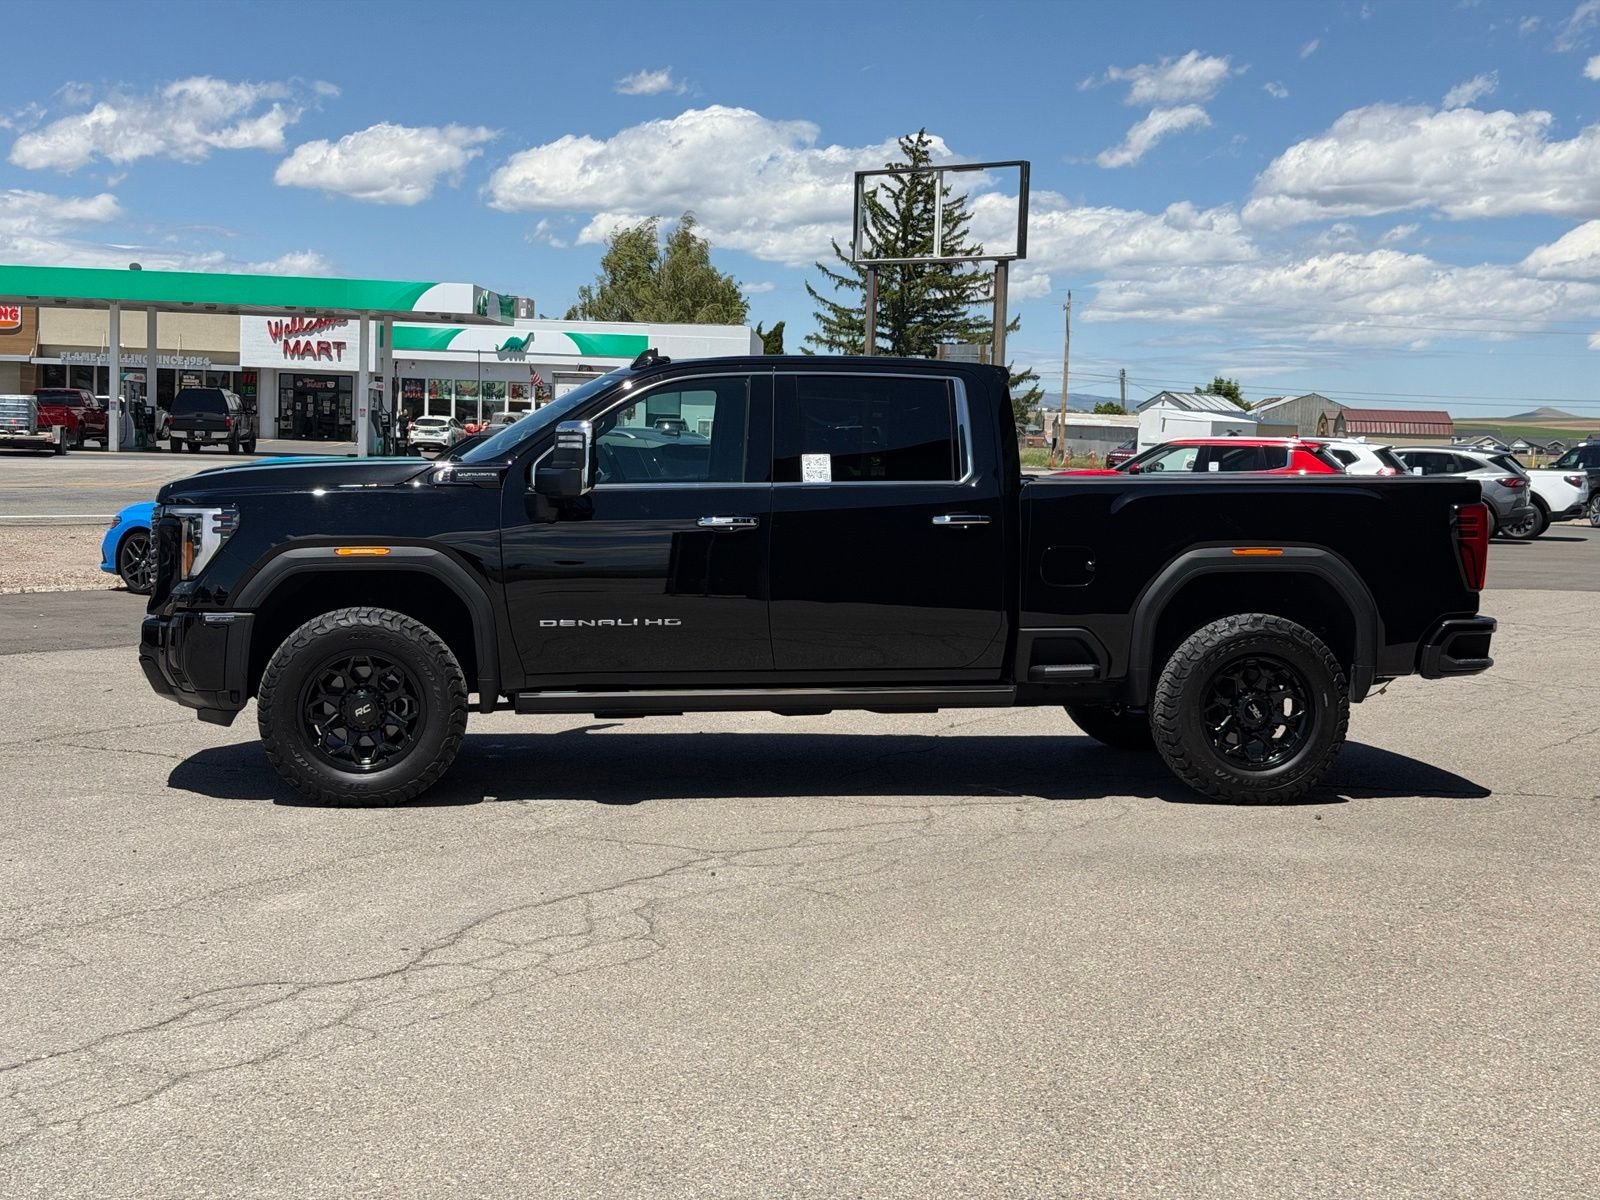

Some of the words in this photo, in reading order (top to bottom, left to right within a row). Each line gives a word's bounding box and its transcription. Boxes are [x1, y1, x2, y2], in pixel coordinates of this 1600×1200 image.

[283, 339, 347, 362] MART
[61, 352, 97, 361] FLAME
[157, 355, 184, 365] INCE
[186, 356, 212, 366] 1954
[540, 618, 638, 627] DENALI
[645, 618, 682, 626] HD
[355, 703, 371, 717] RC
